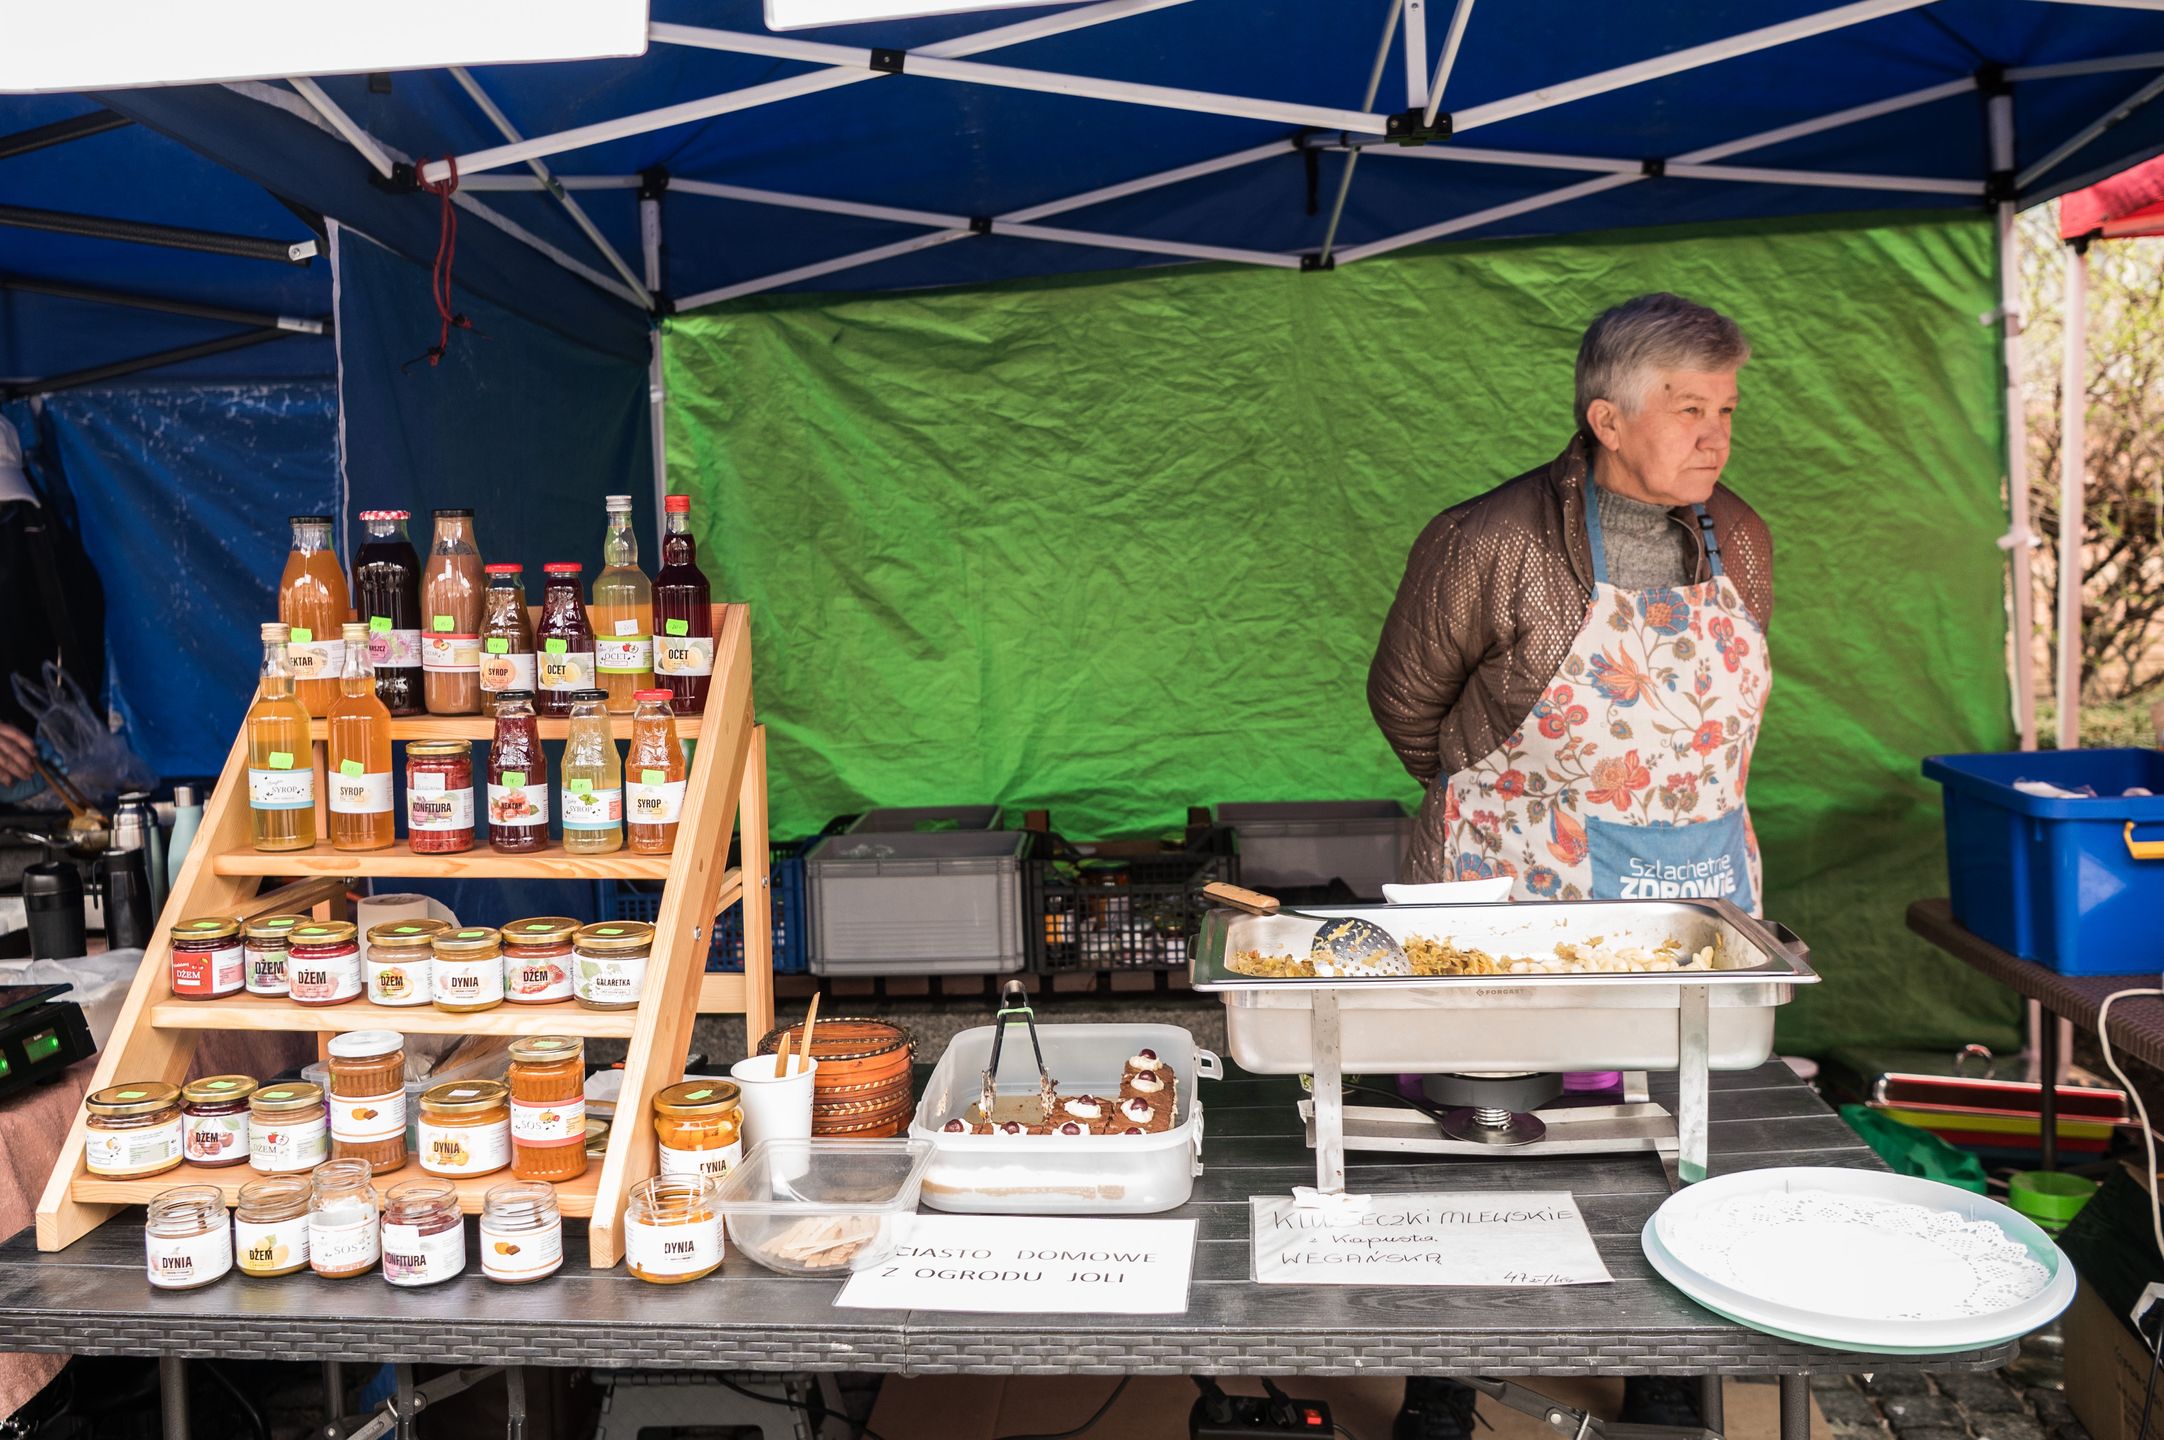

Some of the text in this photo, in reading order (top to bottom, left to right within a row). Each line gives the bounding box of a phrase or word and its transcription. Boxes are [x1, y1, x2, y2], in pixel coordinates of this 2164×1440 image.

[604, 652, 628, 660] OCET
[668, 649, 689, 660] OCET
[290, 656, 313, 667] EKTAR
[488, 668, 509, 677] SYROP
[547, 665, 567, 675] OCET
[340, 786, 364, 796] SYROP
[413, 802, 451, 813] KONFITURA
[502, 802, 523, 810] NEKTAR
[637, 798, 662, 808] SYROP
[1629, 854, 1731, 881] Szlachetne
[1619, 868, 1737, 900] ZDROWIE
[255, 959, 284, 975] DŻEM
[176, 969, 201, 979] DŻEM
[298, 969, 326, 984] DŻEM
[523, 967, 548, 982] DŻEM
[381, 974, 403, 986] DŻEM
[451, 976, 479, 988] DYNIA
[596, 978, 631, 987] GALARETKA
[1485, 988, 1524, 996] FORGAST
[521, 1121, 542, 1130] SOS
[196, 1130, 219, 1142] DŻEM
[434, 1142, 460, 1153] DYNIA
[334, 1245, 358, 1255] SOS
[664, 1240, 694, 1254] DYNIA
[249, 1248, 273, 1261] DŻEM
[384, 1251, 427, 1267] KONFITURA
[895, 1245, 1157, 1263] CIASTO DOMOWE
[162, 1256, 192, 1269] DYNIA
[881, 1267, 1125, 1283] Z OGRODU JOLI
